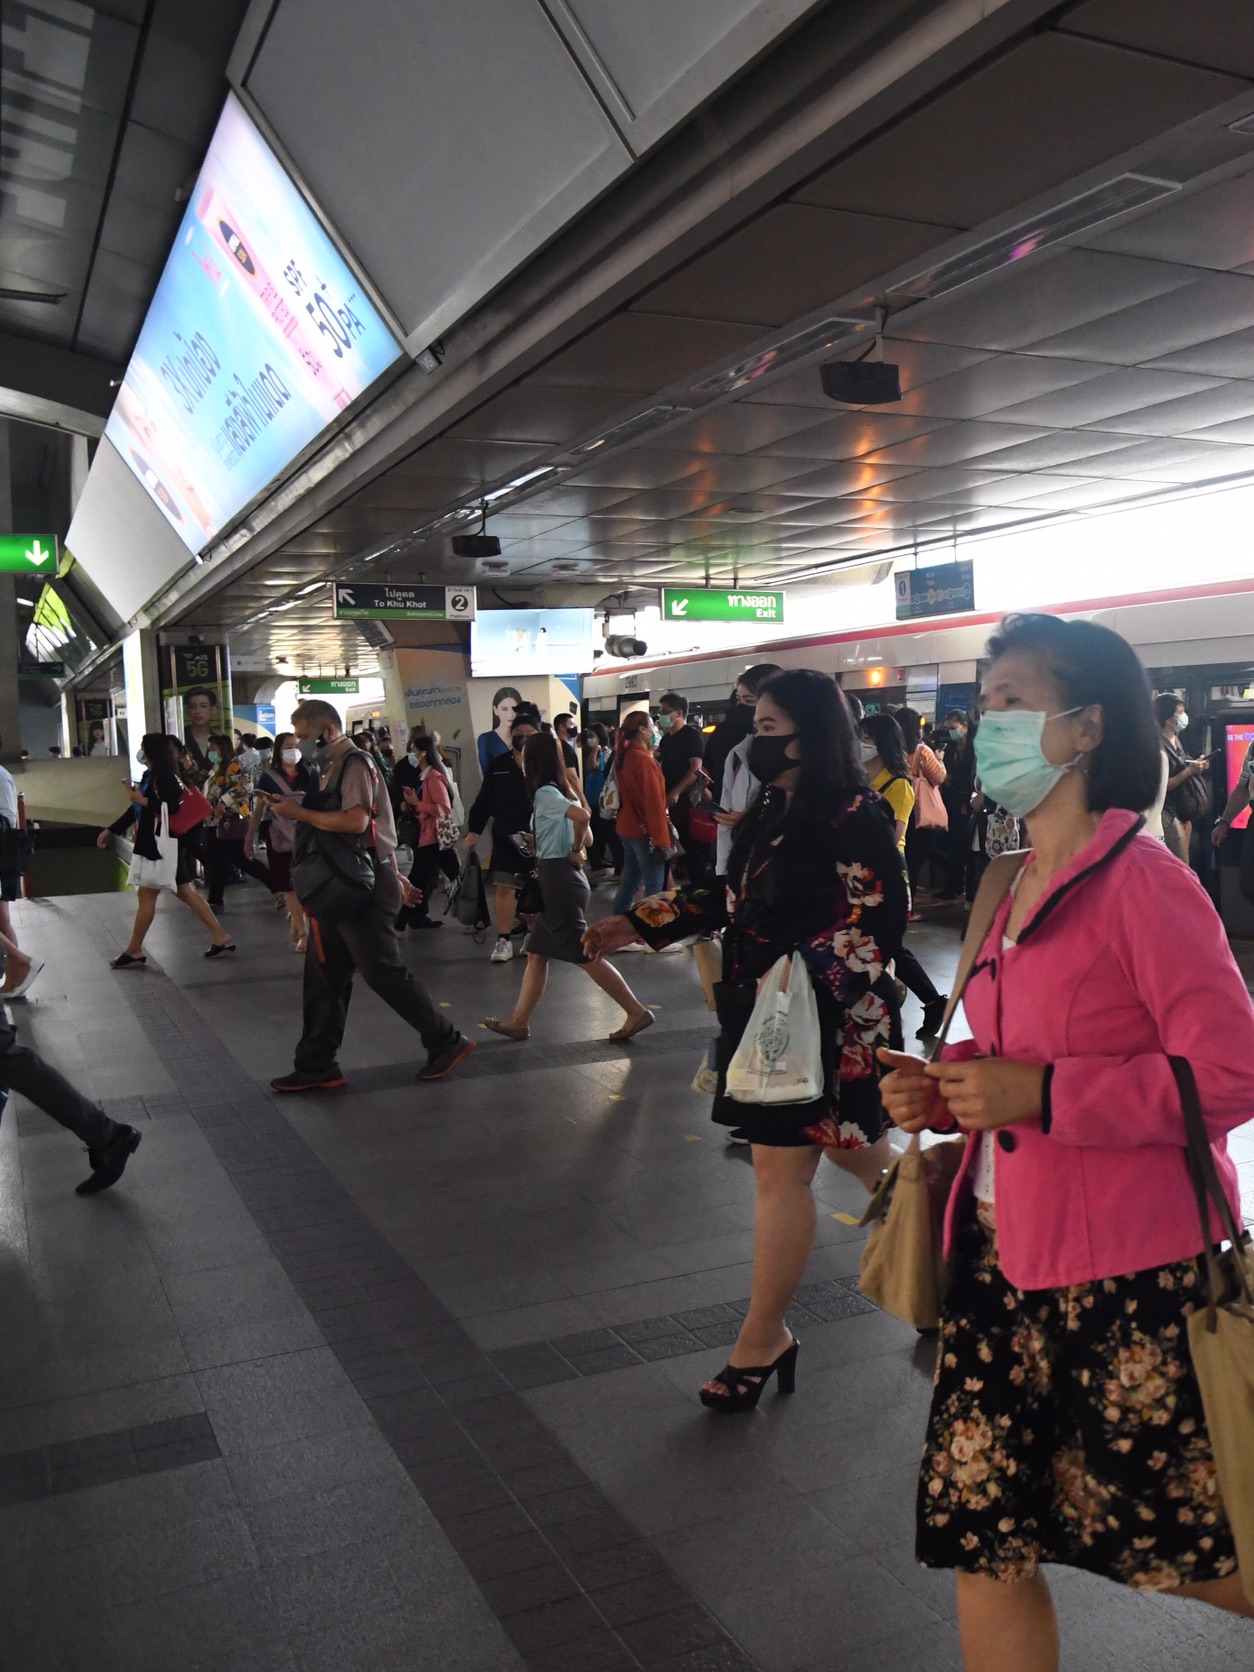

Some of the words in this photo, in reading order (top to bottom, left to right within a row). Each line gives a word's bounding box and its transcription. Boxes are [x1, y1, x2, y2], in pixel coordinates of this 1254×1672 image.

[283, 259, 307, 296] SPF
[384, 587, 415, 600] ไปคูคต
[374, 600, 385, 608] To
[387, 600, 404, 608] Khu
[406, 600, 427, 608] Khot
[454, 596, 465, 610] 2
[727, 595, 776, 608] ทางออก
[756, 608, 776, 618] Exit
[186, 660, 209, 677] 5G
